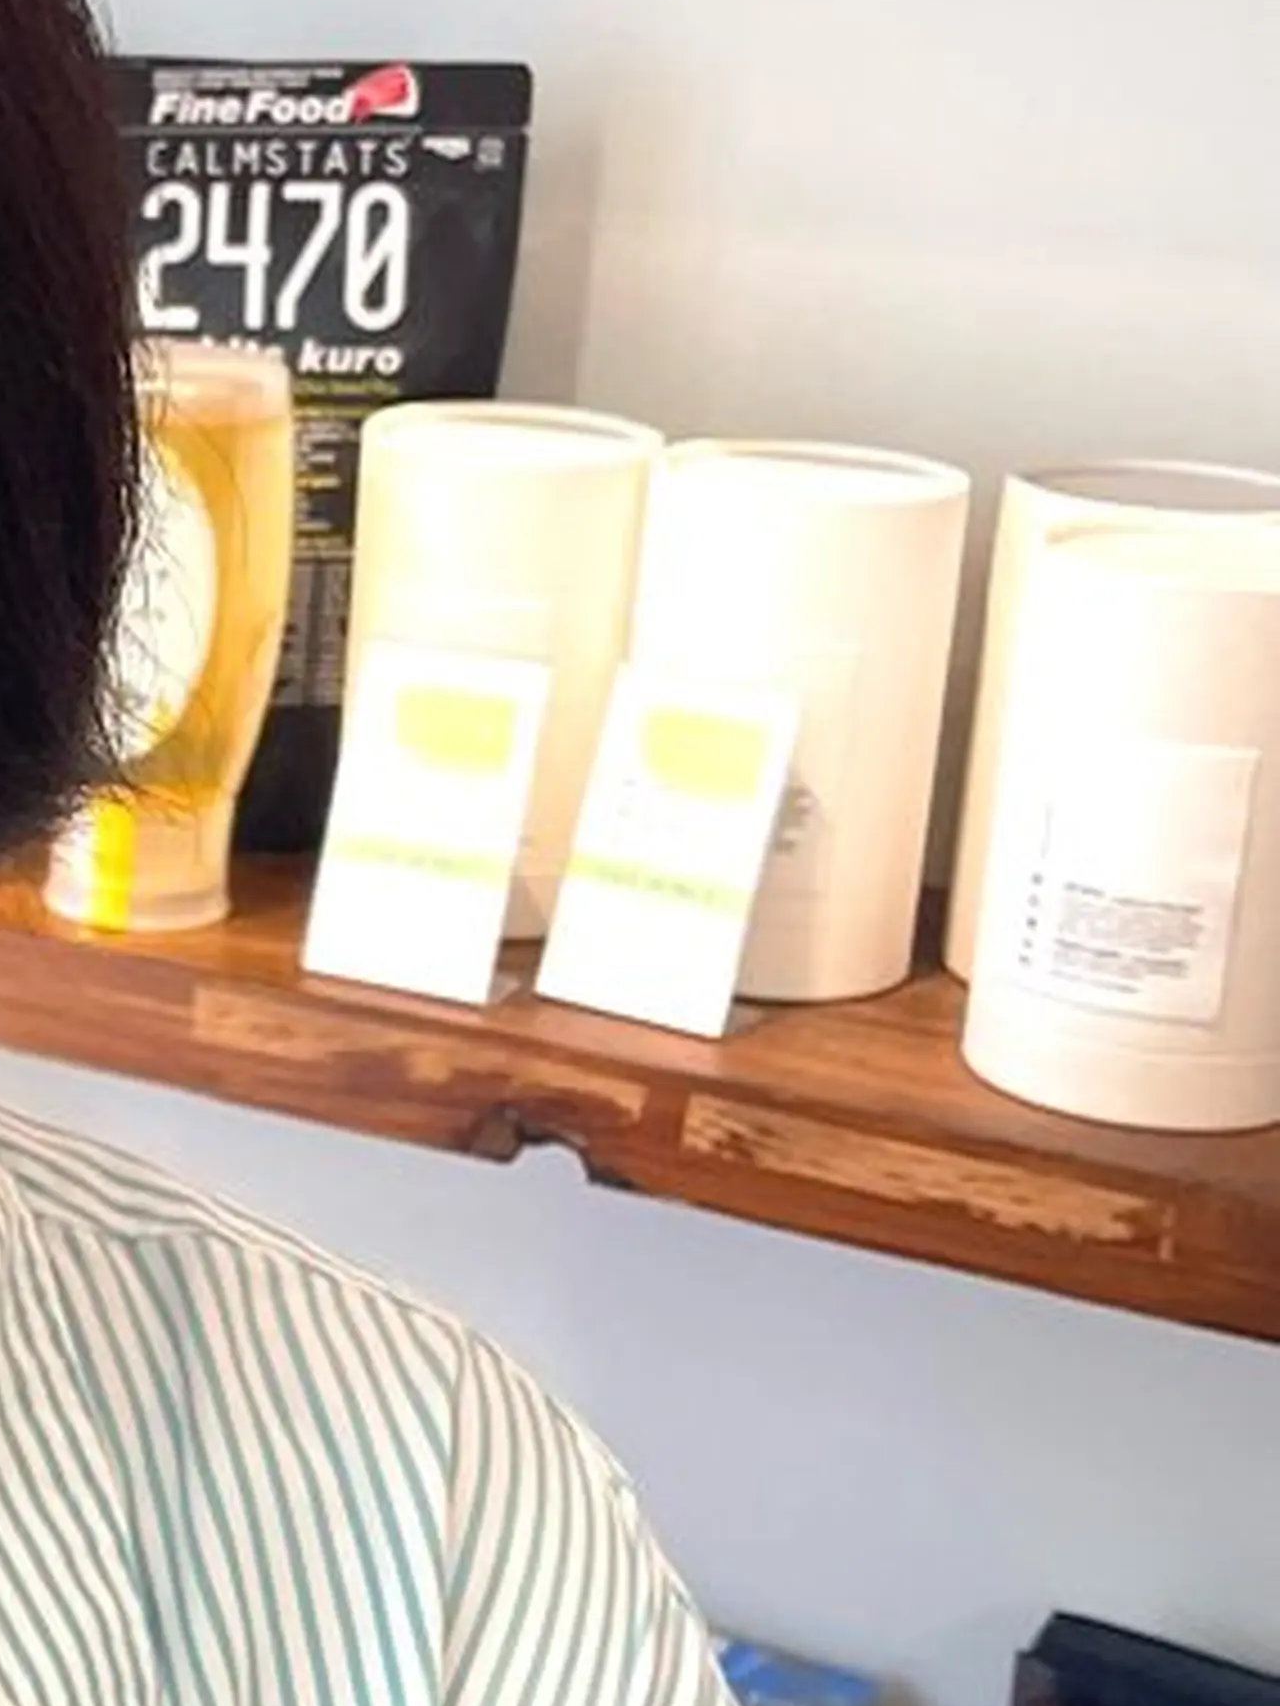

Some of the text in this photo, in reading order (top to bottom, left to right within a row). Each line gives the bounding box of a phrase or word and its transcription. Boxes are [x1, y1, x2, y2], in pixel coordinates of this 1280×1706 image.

[146, 141, 409, 176] CALMSTATS
[138, 180, 409, 332] 2470
[296, 338, 406, 376] kuro
